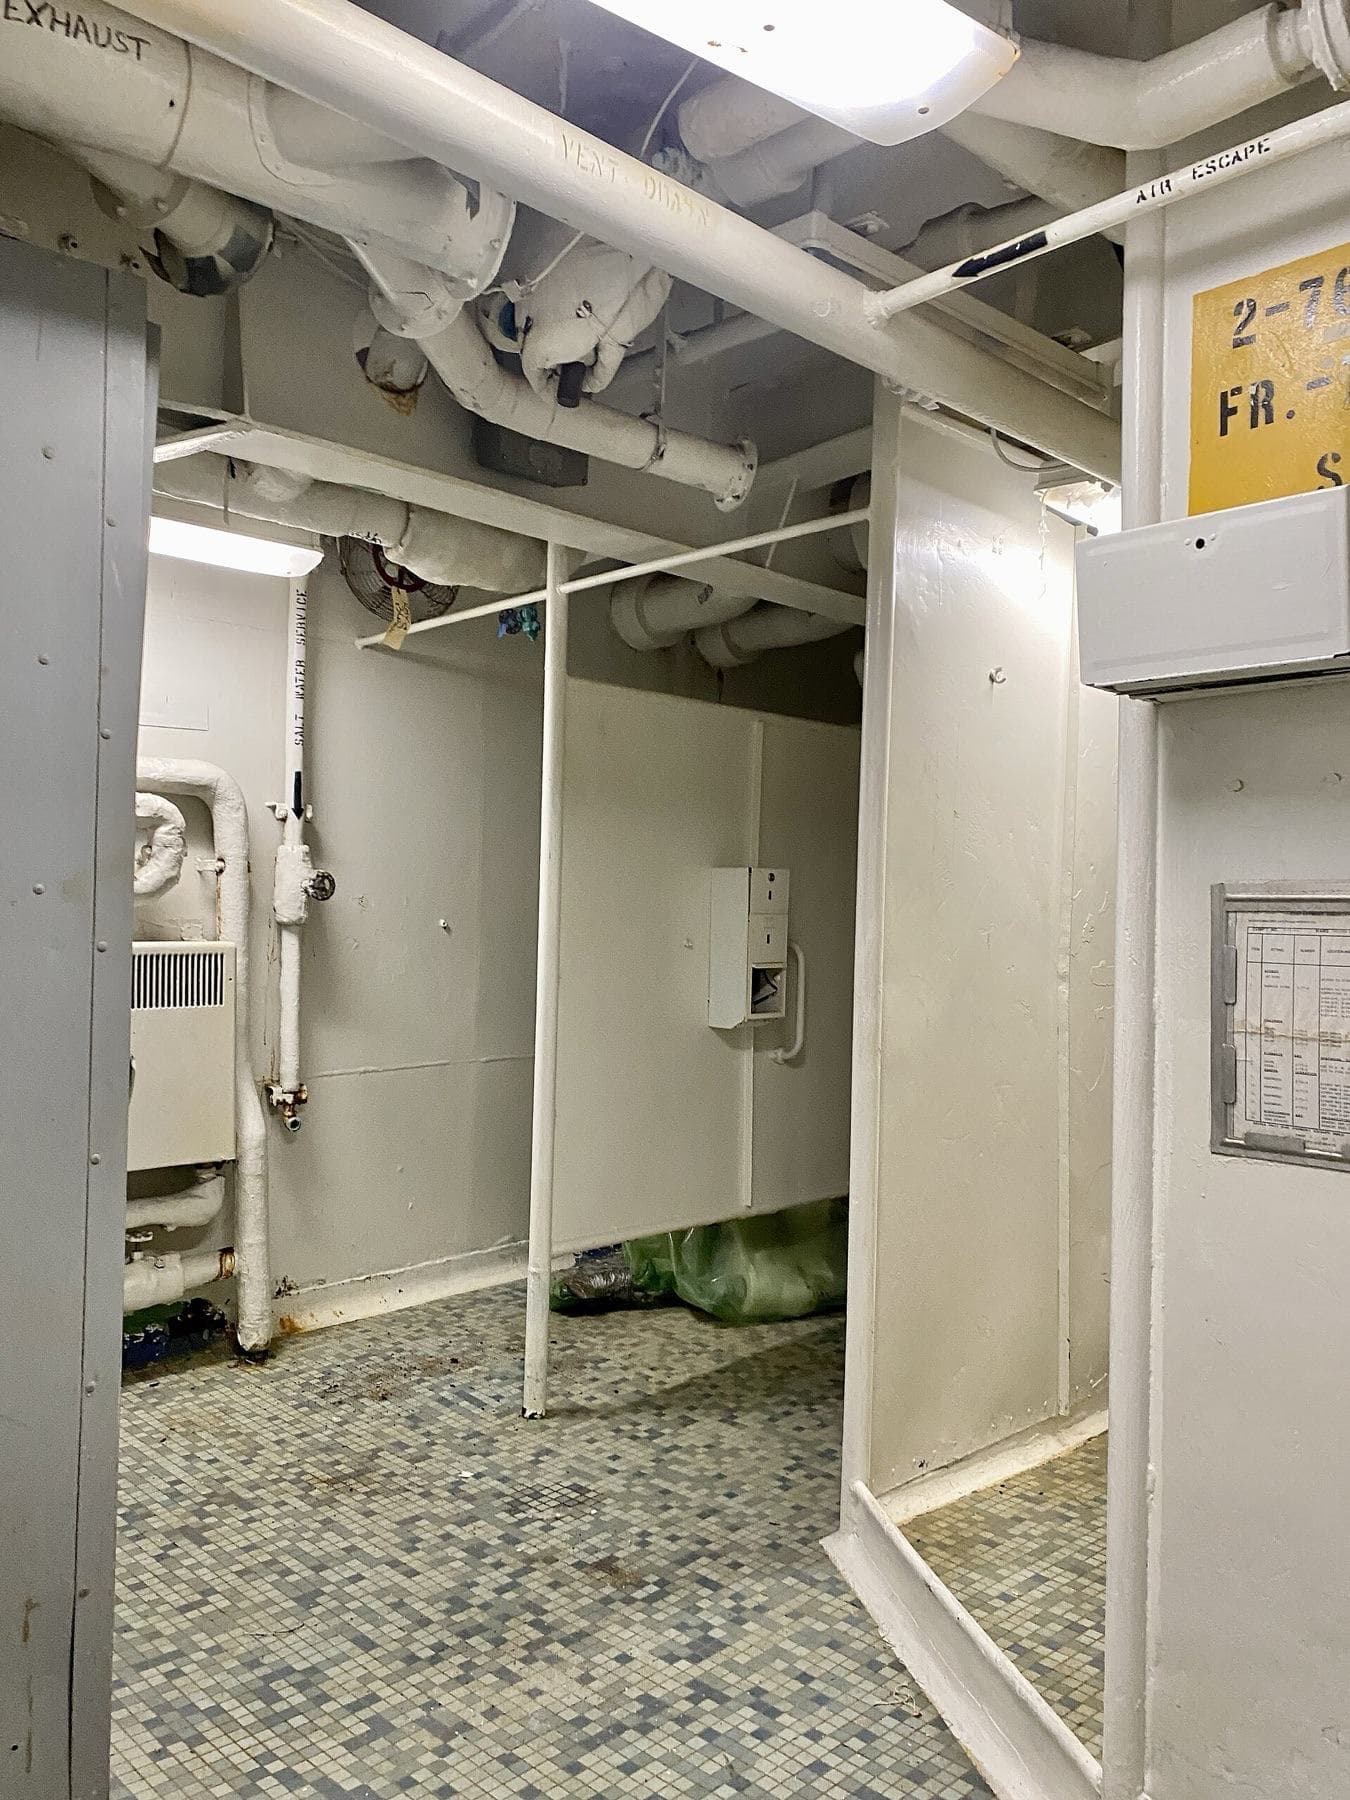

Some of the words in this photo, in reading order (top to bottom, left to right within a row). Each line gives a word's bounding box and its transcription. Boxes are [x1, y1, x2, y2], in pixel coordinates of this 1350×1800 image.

[3, 0, 152, 61] EXHAUST
[1136, 179, 1172, 204] AIR
[1192, 138, 1271, 180] ESCAPE
[1219, 379, 1296, 437] FR.
[295, 588, 307, 645] SERVICE
[294, 659, 306, 699] WATER
[294, 713, 305, 746] SALT
